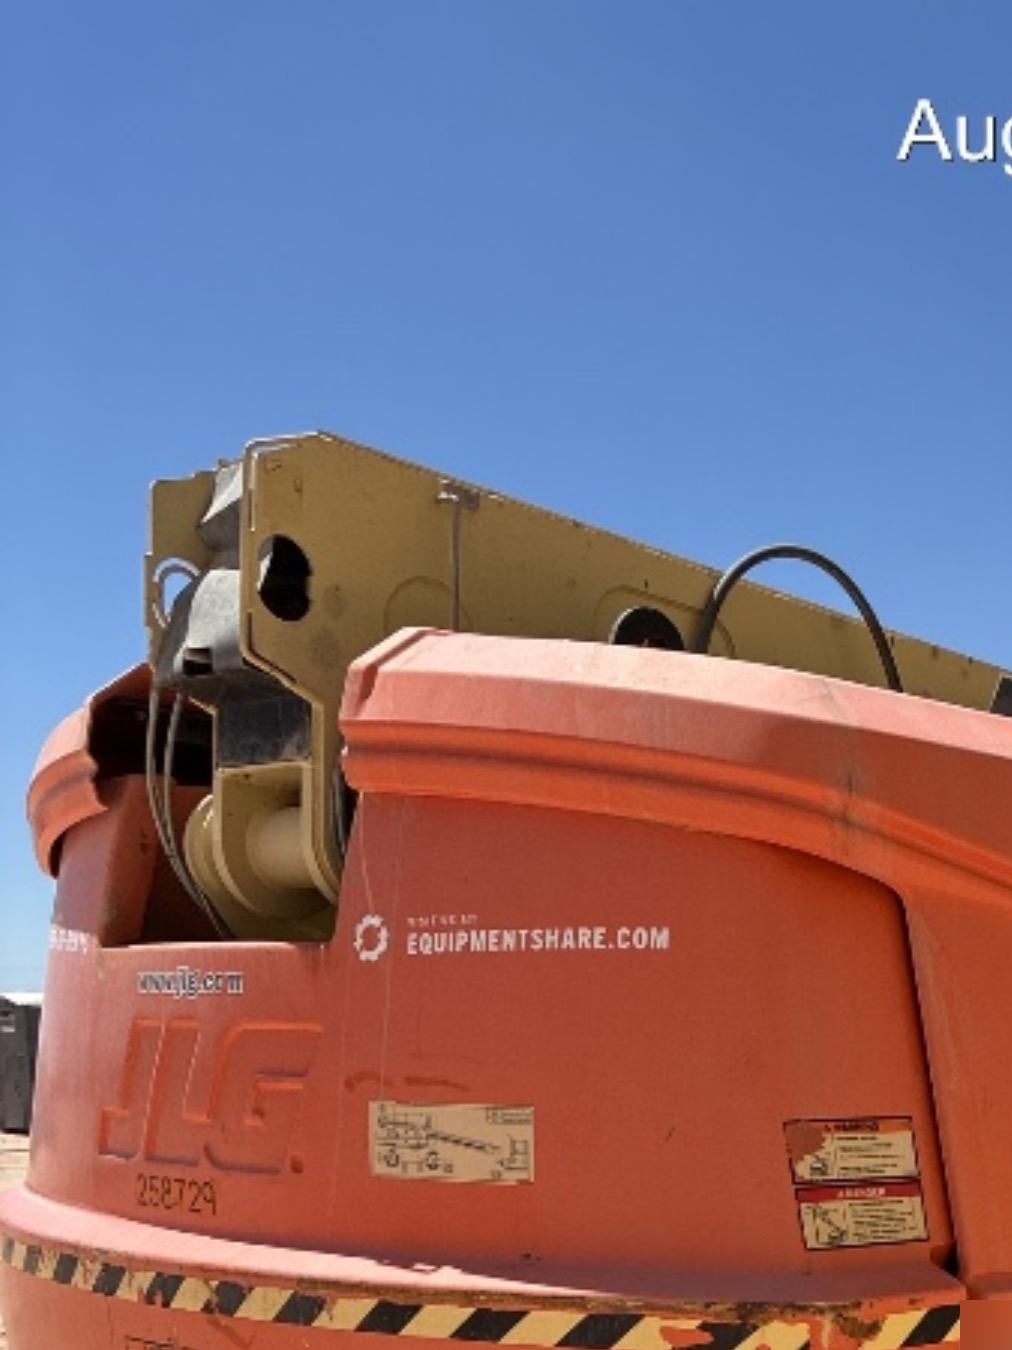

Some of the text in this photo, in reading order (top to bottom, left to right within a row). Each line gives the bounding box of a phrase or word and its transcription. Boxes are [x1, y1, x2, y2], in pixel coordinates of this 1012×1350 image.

[407, 926, 671, 956] EQUIPMENTSHARE.COM
[137, 966, 243, 999] www.jlg.com
[136, 1173, 217, 1215] 258729
